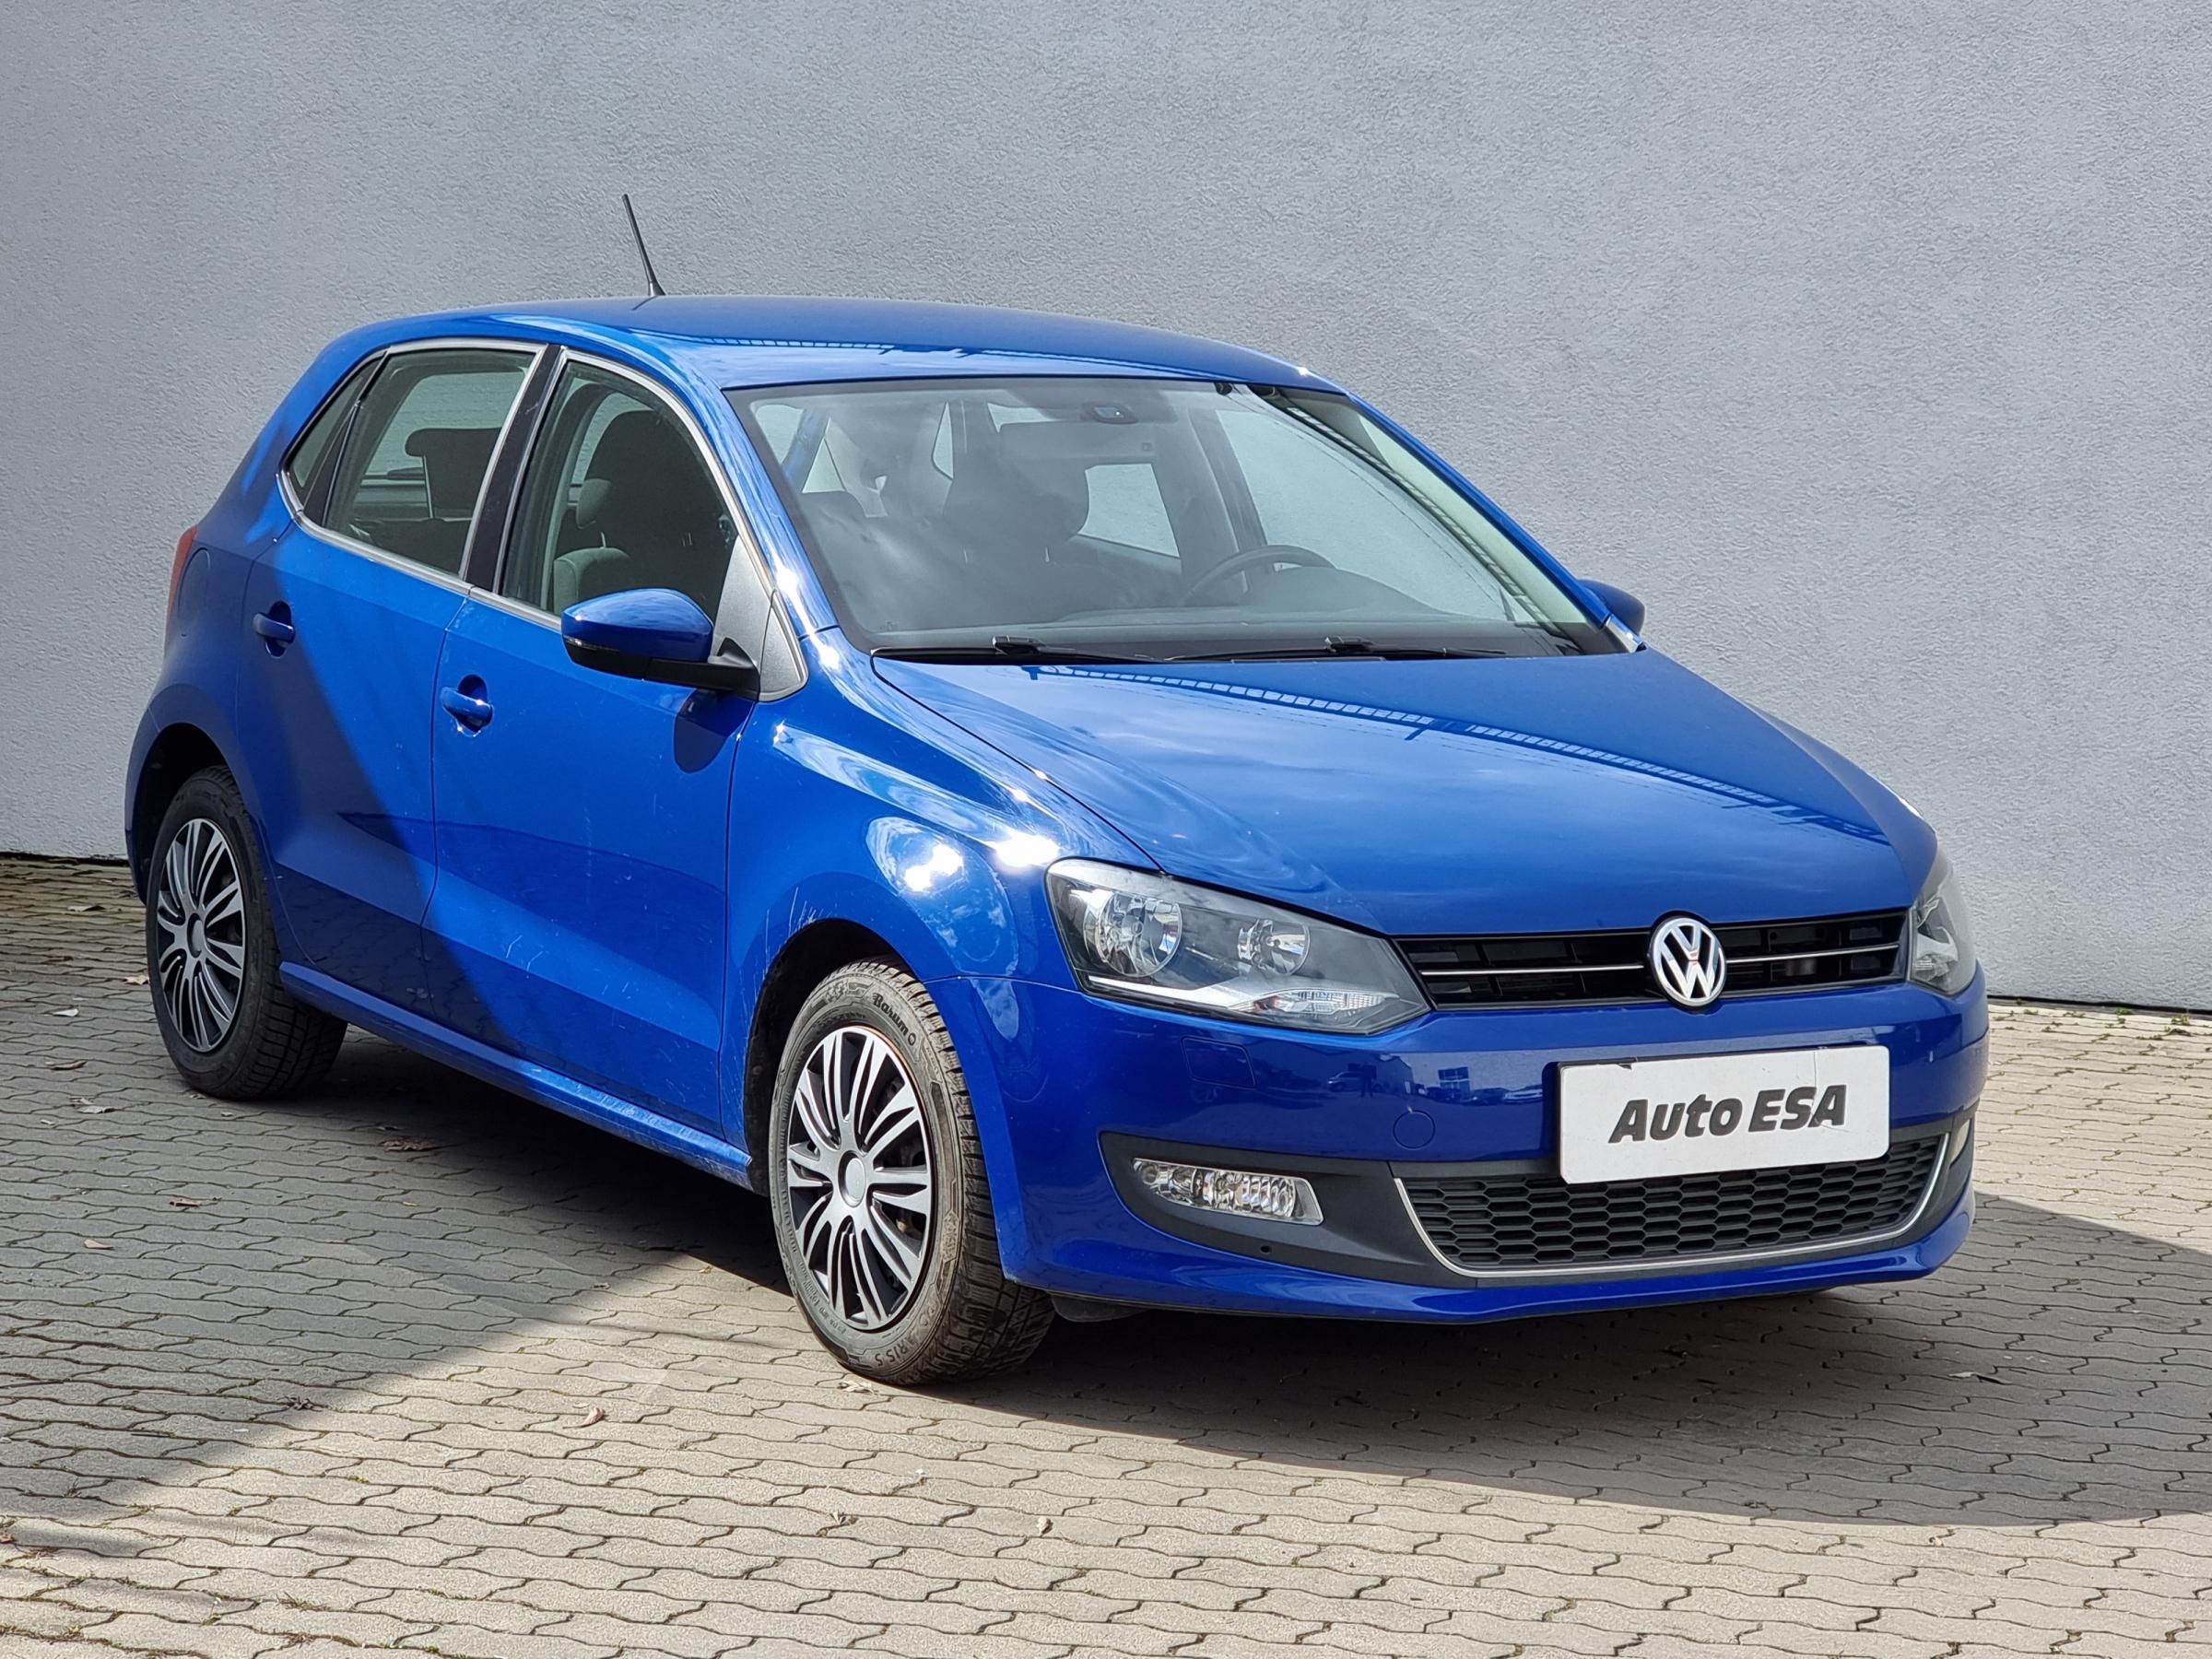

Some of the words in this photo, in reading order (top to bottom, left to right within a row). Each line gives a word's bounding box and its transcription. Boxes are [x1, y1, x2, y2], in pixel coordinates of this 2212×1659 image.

[871, 992, 909, 1036] Barum
[1608, 1094, 1743, 1144] Auto
[1747, 1084, 1847, 1133] ESA
